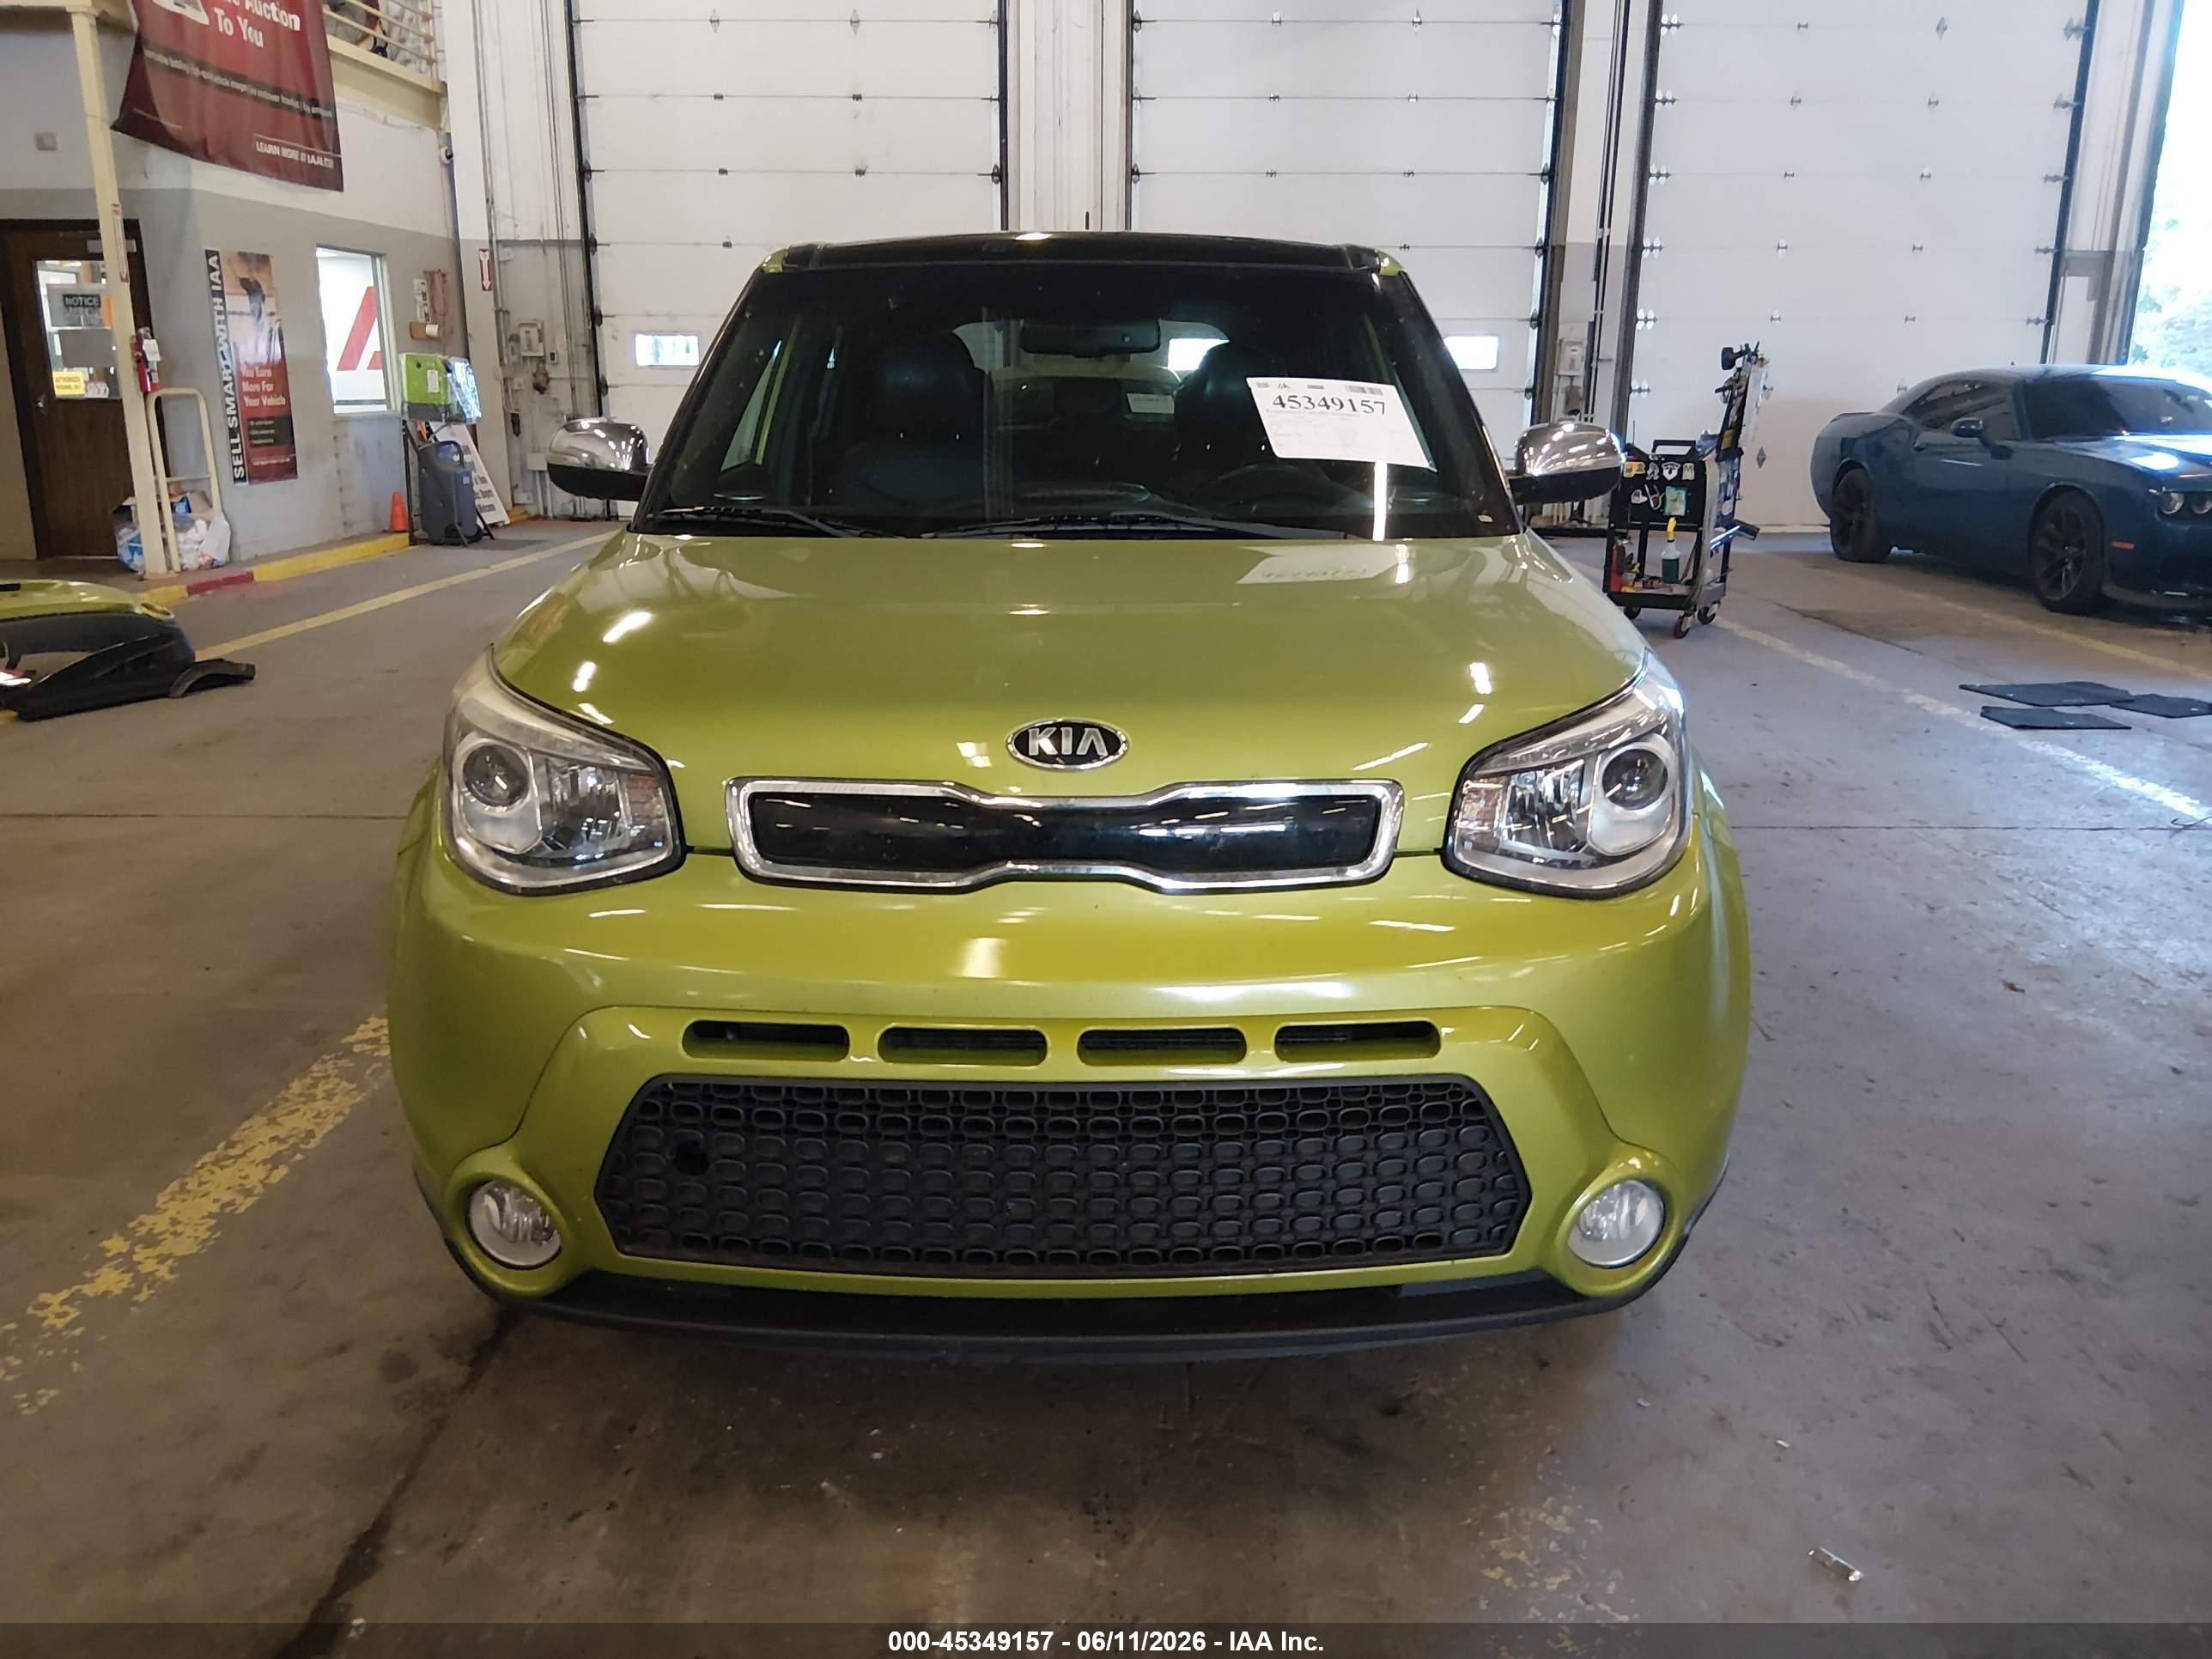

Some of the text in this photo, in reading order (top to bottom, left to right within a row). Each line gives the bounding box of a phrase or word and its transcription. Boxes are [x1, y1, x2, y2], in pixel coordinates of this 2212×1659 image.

[214, 7, 264, 48] To You
[245, 0, 301, 32] Auction
[256, 141, 280, 155] LEARN
[209, 256, 222, 291] IAA
[64, 296, 100, 307] NOTICE
[212, 297, 229, 348] WITH
[243, 395, 260, 408] Your
[1273, 394, 1385, 415] 45349157
[229, 432, 245, 478] SELL
[1028, 727, 1108, 757] KIA
